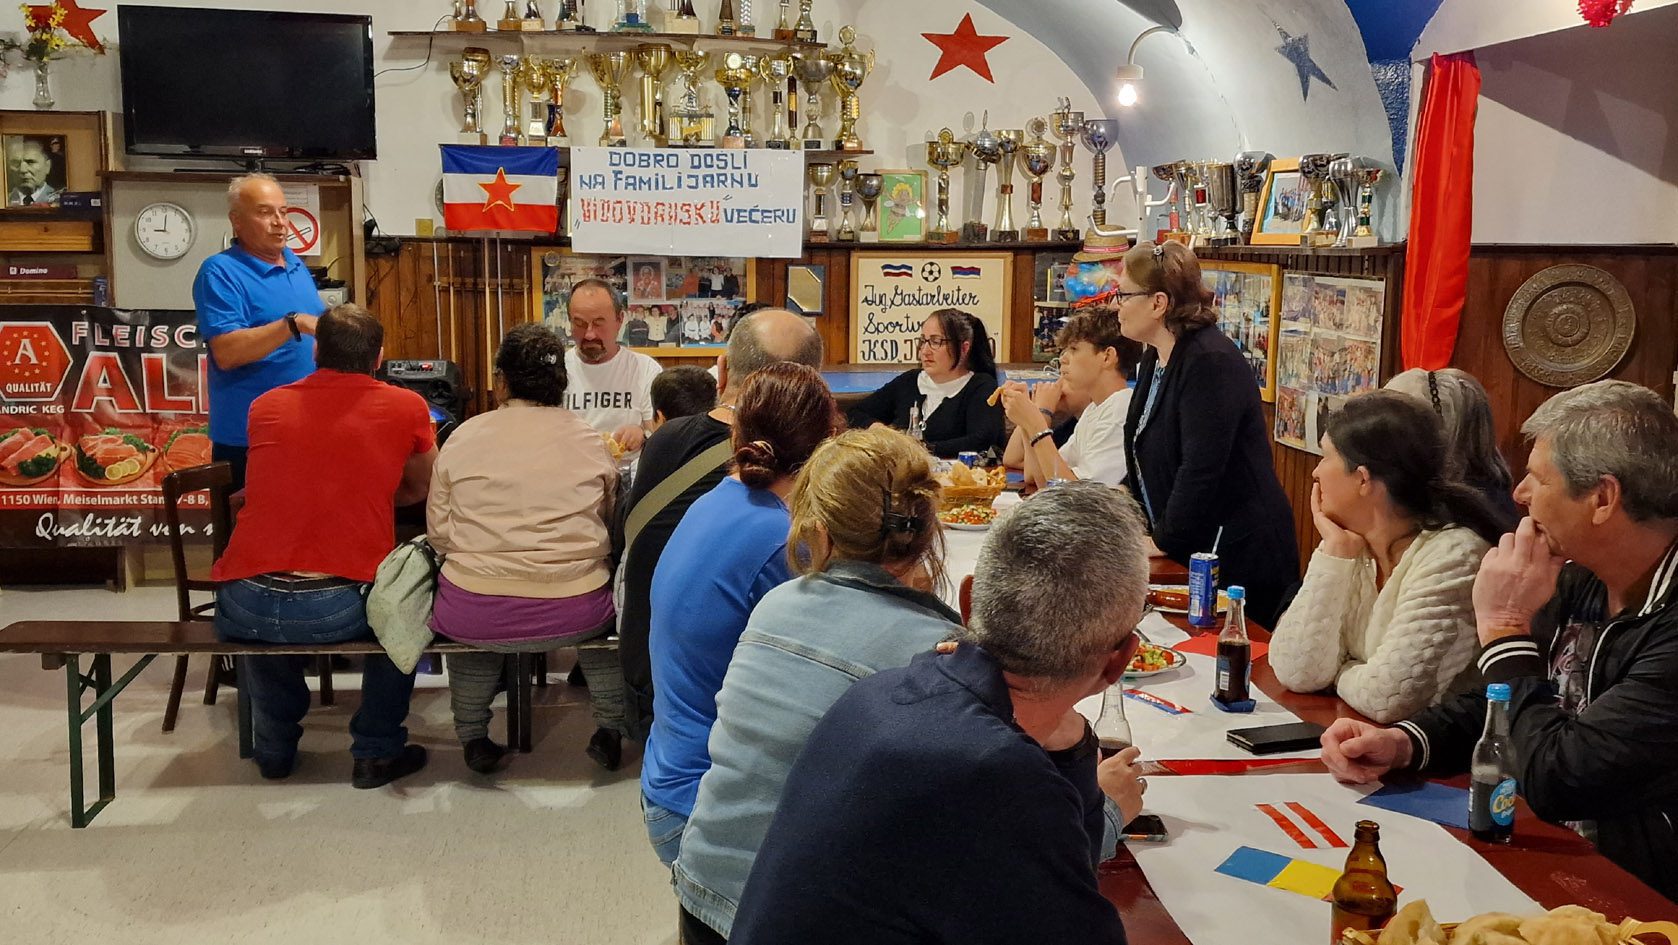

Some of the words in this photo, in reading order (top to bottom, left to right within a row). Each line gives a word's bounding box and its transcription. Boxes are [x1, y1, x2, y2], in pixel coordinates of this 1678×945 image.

[608, 151, 679, 169] DOBRO
[578, 173, 606, 191] NA
[19, 267, 48, 275] Domino
[889, 284, 980, 308] Gastarbeiter
[71, 321, 207, 348] FLEISC
[14, 338, 38, 364] A
[6, 382, 52, 394] QUALITÄT
[0, 404, 37, 415] NDRIC
[42, 404, 65, 414] KEG
[1, 494, 31, 506] 1150
[63, 493, 139, 505] Meiselmarkt
[35, 512, 142, 541] Qualität
